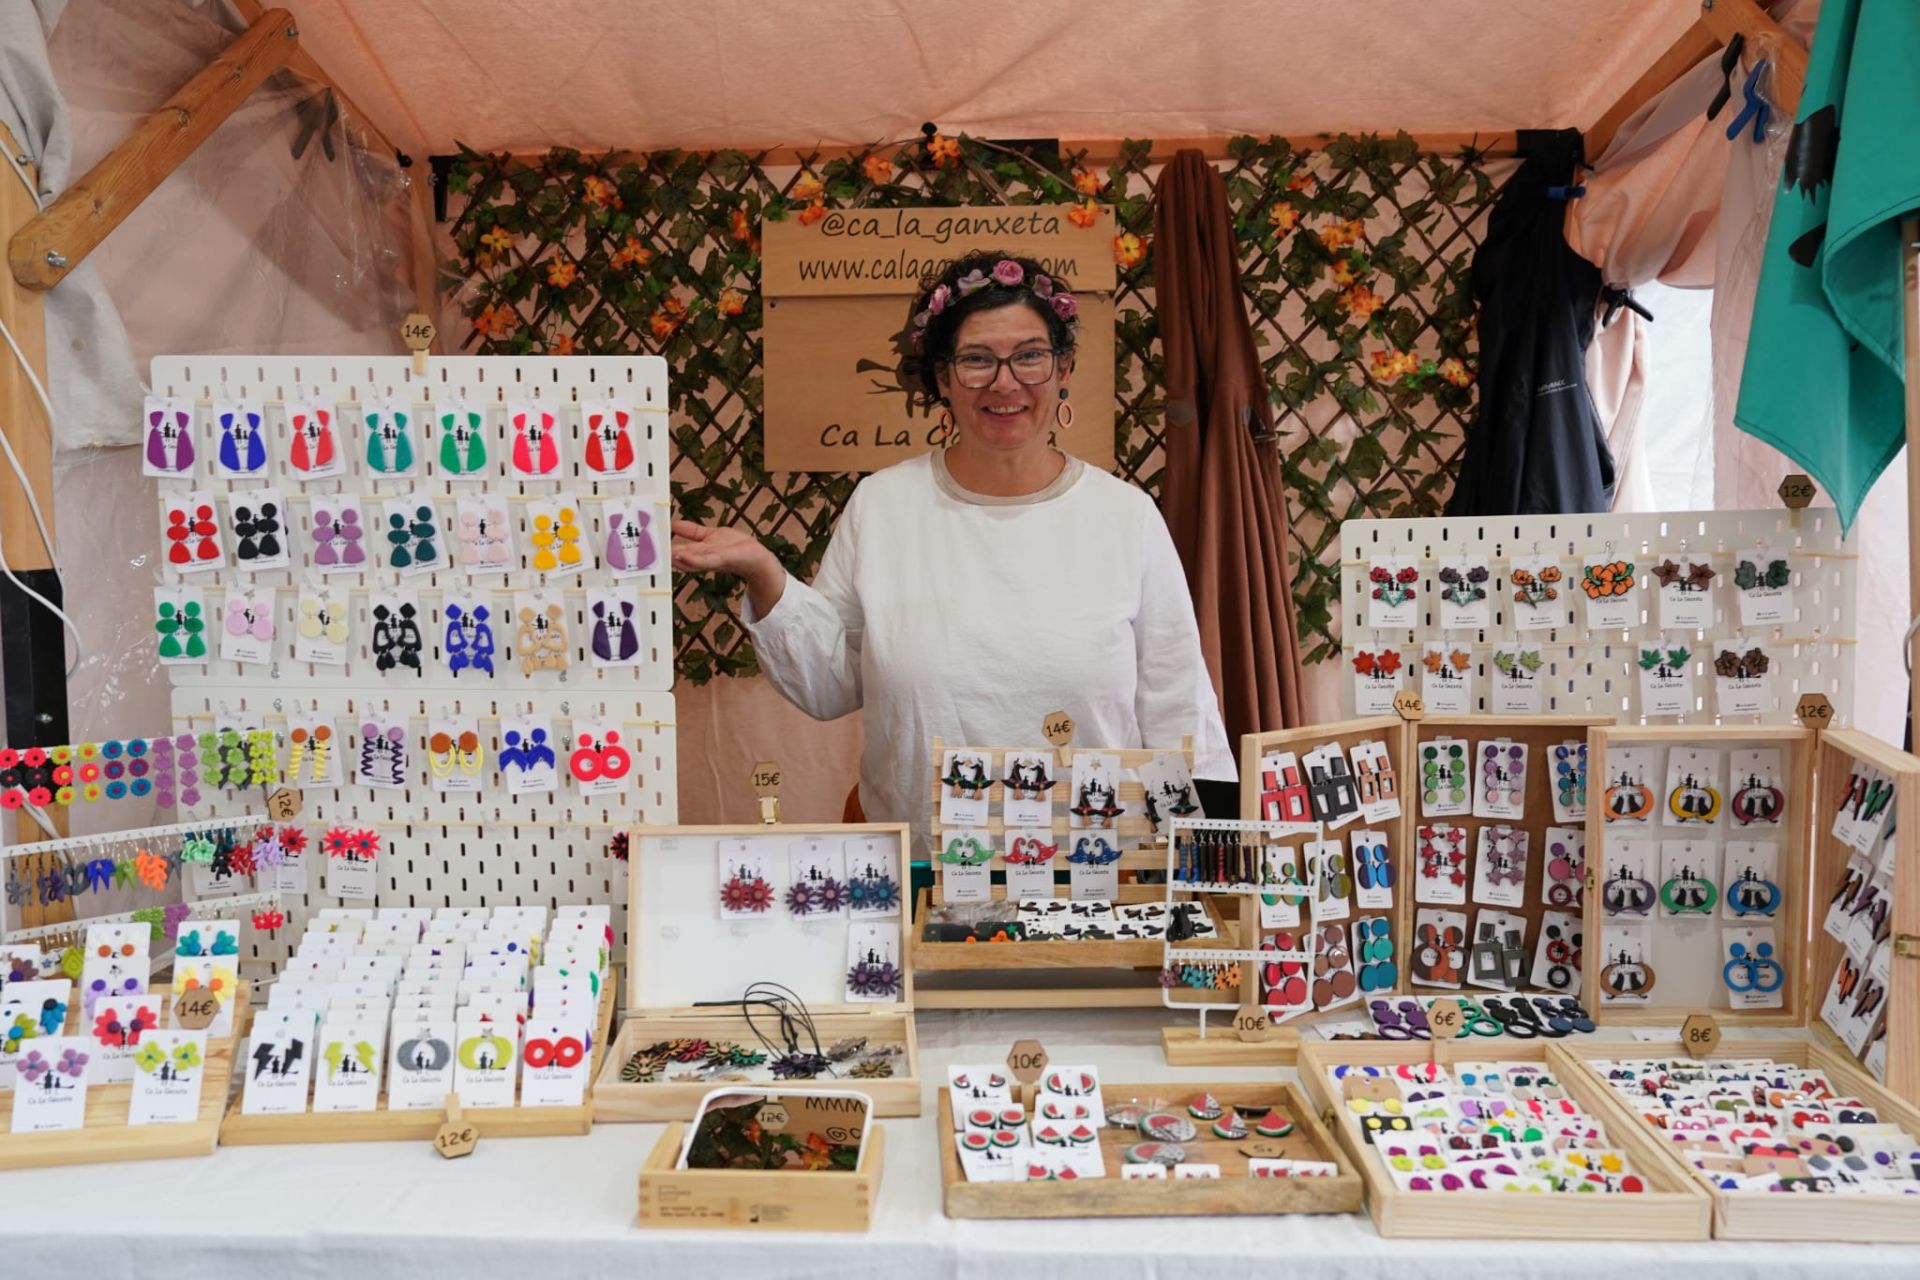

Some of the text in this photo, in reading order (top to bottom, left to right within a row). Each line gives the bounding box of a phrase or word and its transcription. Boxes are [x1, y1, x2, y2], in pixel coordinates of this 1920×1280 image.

[820, 210, 1060, 244] @ca_la_ganxeta
[405, 325, 431, 338] 14€
[820, 423, 859, 447] Ca
[874, 425, 911, 447] La
[1784, 484, 1811, 498] 12€
[1398, 699, 1421, 711] 14€
[1800, 705, 1828, 718] 12€
[1047, 720, 1071, 737] 14€
[754, 772, 781, 786] 15€
[278, 793, 294, 818] 12€
[180, 1000, 213, 1017] 14€
[1238, 1016, 1265, 1031] 10€
[1434, 1010, 1456, 1026] 6€
[1690, 1028, 1712, 1042] 8€
[1013, 1053, 1042, 1069] 10€
[440, 1128, 472, 1148] 12€
